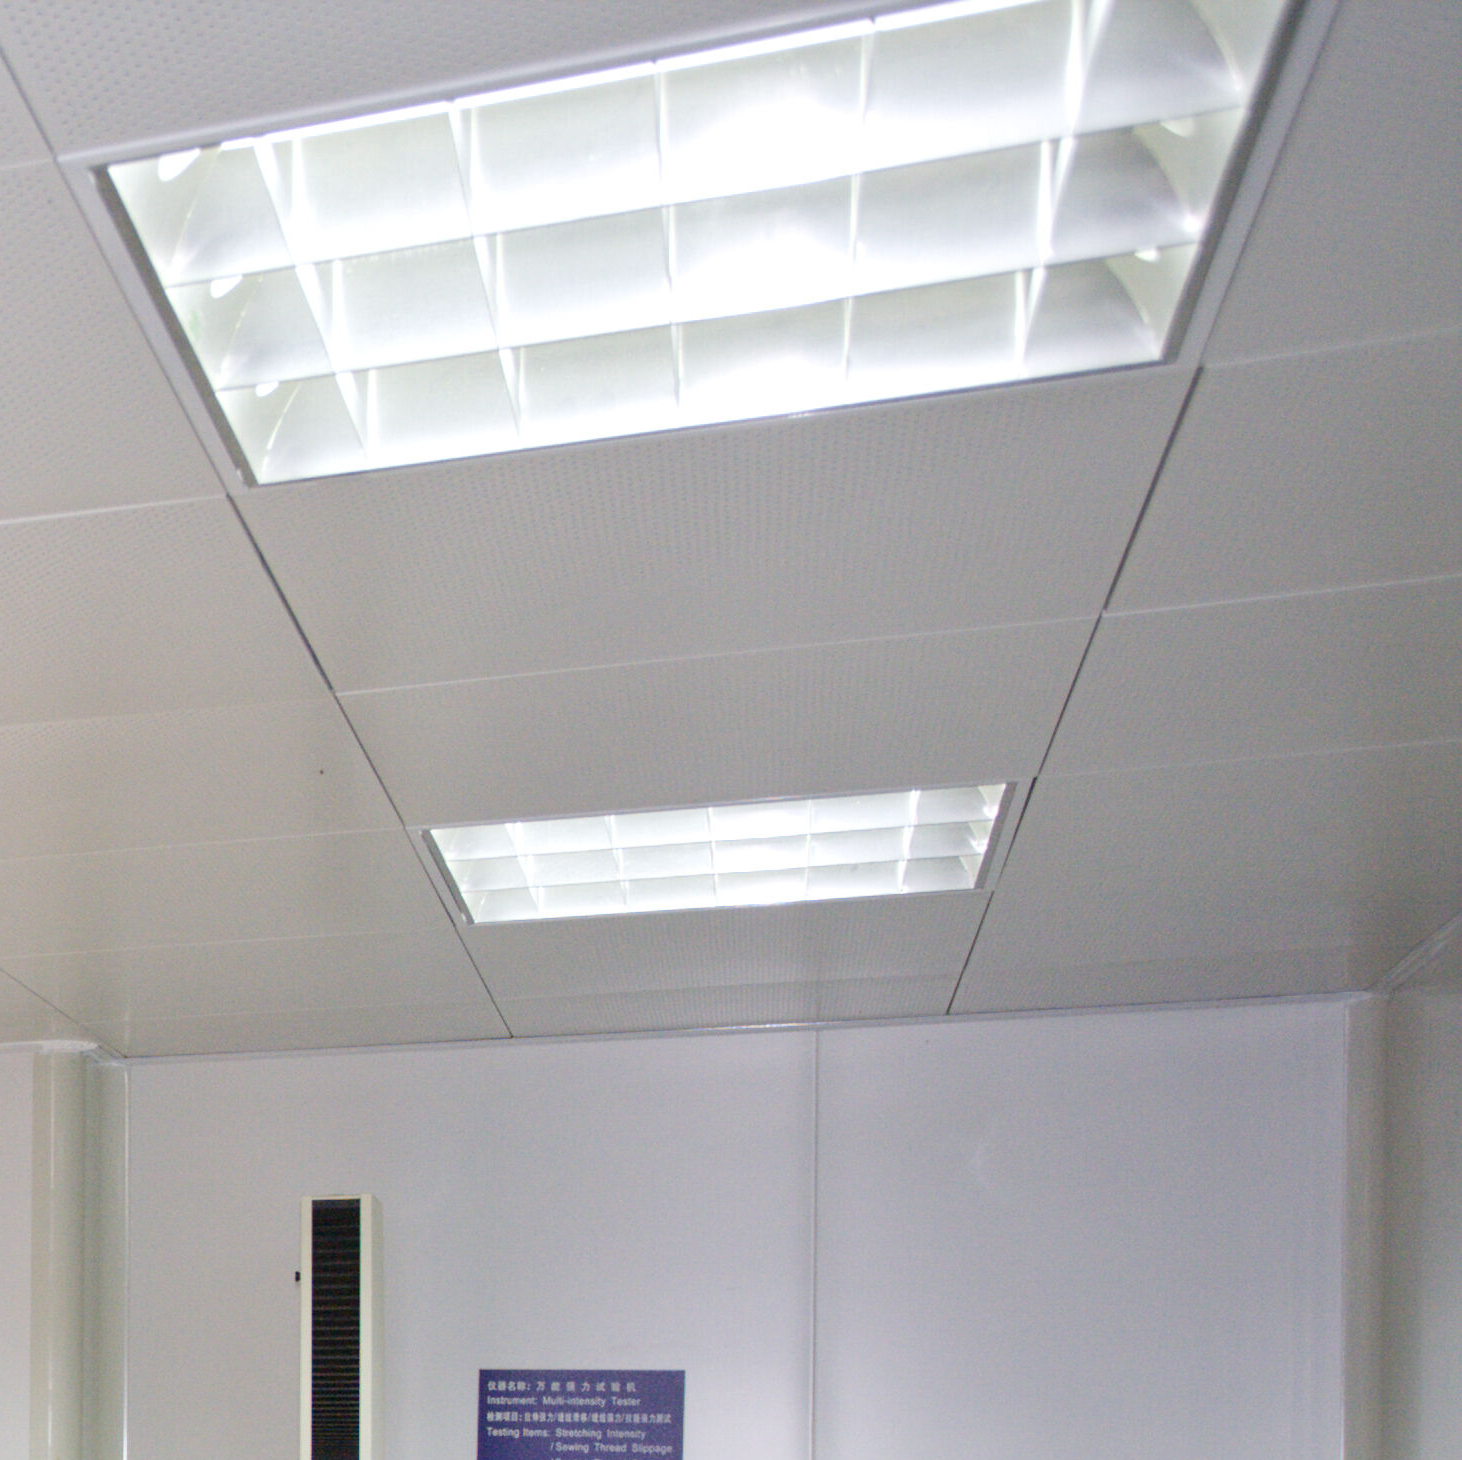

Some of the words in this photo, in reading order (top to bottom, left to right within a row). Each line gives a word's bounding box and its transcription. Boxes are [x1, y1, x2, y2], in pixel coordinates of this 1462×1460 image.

[487, 1396, 538, 1405] Instrument:
[611, 1397, 641, 1406] Tester
[487, 1427, 520, 1438] Testing
[555, 1428, 602, 1440] Stretching
[607, 1429, 646, 1440] Intensity
[595, 1443, 627, 1453] Thread
[631, 1443, 673, 1454] Slippage
